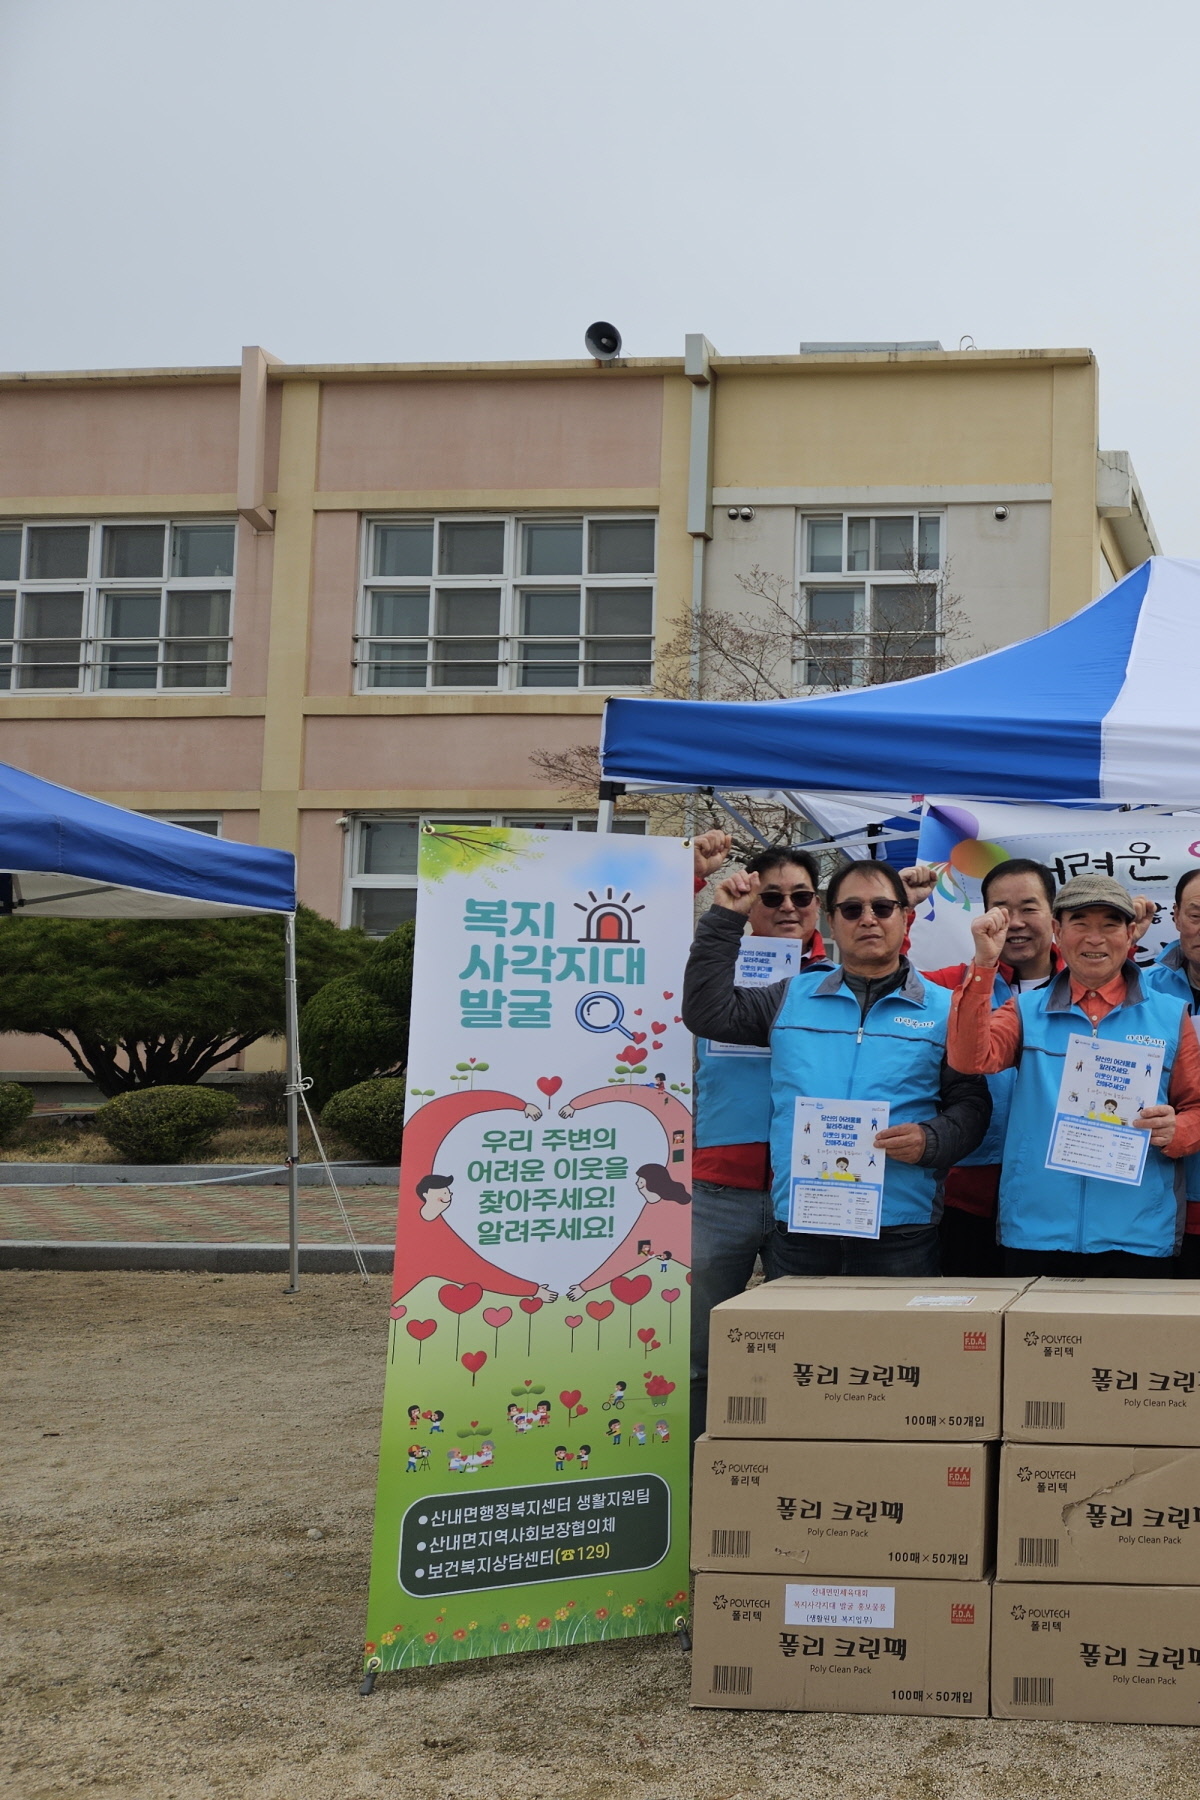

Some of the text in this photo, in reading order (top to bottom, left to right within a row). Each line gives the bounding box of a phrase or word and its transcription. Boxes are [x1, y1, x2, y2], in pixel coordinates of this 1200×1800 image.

[463, 898, 555, 940] 복지
[459, 944, 646, 986] 사각지대
[459, 989, 552, 1029] 발굴
[481, 1128, 617, 1153] 우리 주변의
[467, 1156, 629, 1184] 어려운 이웃을
[478, 1186, 615, 1215] 찾아주세요!
[477, 1215, 614, 1246] 알려주세요!
[745, 1332, 784, 1340] POLYTECH
[1042, 1335, 1082, 1344] POLYTECH
[747, 1343, 776, 1353] 폴리텍
[1044, 1347, 1073, 1357] 폴리텍
[793, 1363, 919, 1387] 폴리 크린팩
[1092, 1368, 1137, 1391] 폴리
[825, 1393, 841, 1402] Poly
[844, 1393, 865, 1401] Clean
[1125, 1399, 1141, 1408] Poly
[729, 1464, 768, 1473] POLYTECH
[1035, 1471, 1075, 1479] POLYTECH
[731, 1476, 759, 1486] 폴리텍
[1037, 1482, 1067, 1493] 폴리텍
[430, 1487, 650, 1528] 산내면행정복지센터 생활지원팀
[777, 1497, 903, 1524] 폴리 크린팩
[1086, 1503, 1132, 1528] 폴리
[429, 1517, 616, 1554] 산내면지역사회보장협의체
[808, 1528, 824, 1537] Poly
[851, 1529, 868, 1537] Pack
[1119, 1536, 1135, 1545] Poly
[1164, 1536, 1181, 1544] Pack
[730, 1599, 769, 1608] POLYTECH
[794, 1601, 836, 1610] 복지사각지대
[840, 1602, 854, 1611] 발굴
[732, 1611, 761, 1621] 폴리텍
[1029, 1609, 1069, 1618] POLYTECH
[1031, 1621, 1061, 1632] 폴리텍
[779, 1632, 906, 1661] 폴리 크린팩
[1080, 1643, 1126, 1667] 폴리
[810, 1665, 871, 1674] Poly Clean Pack
[1113, 1675, 1130, 1685] Poly
[1133, 1675, 1155, 1684] Clean
